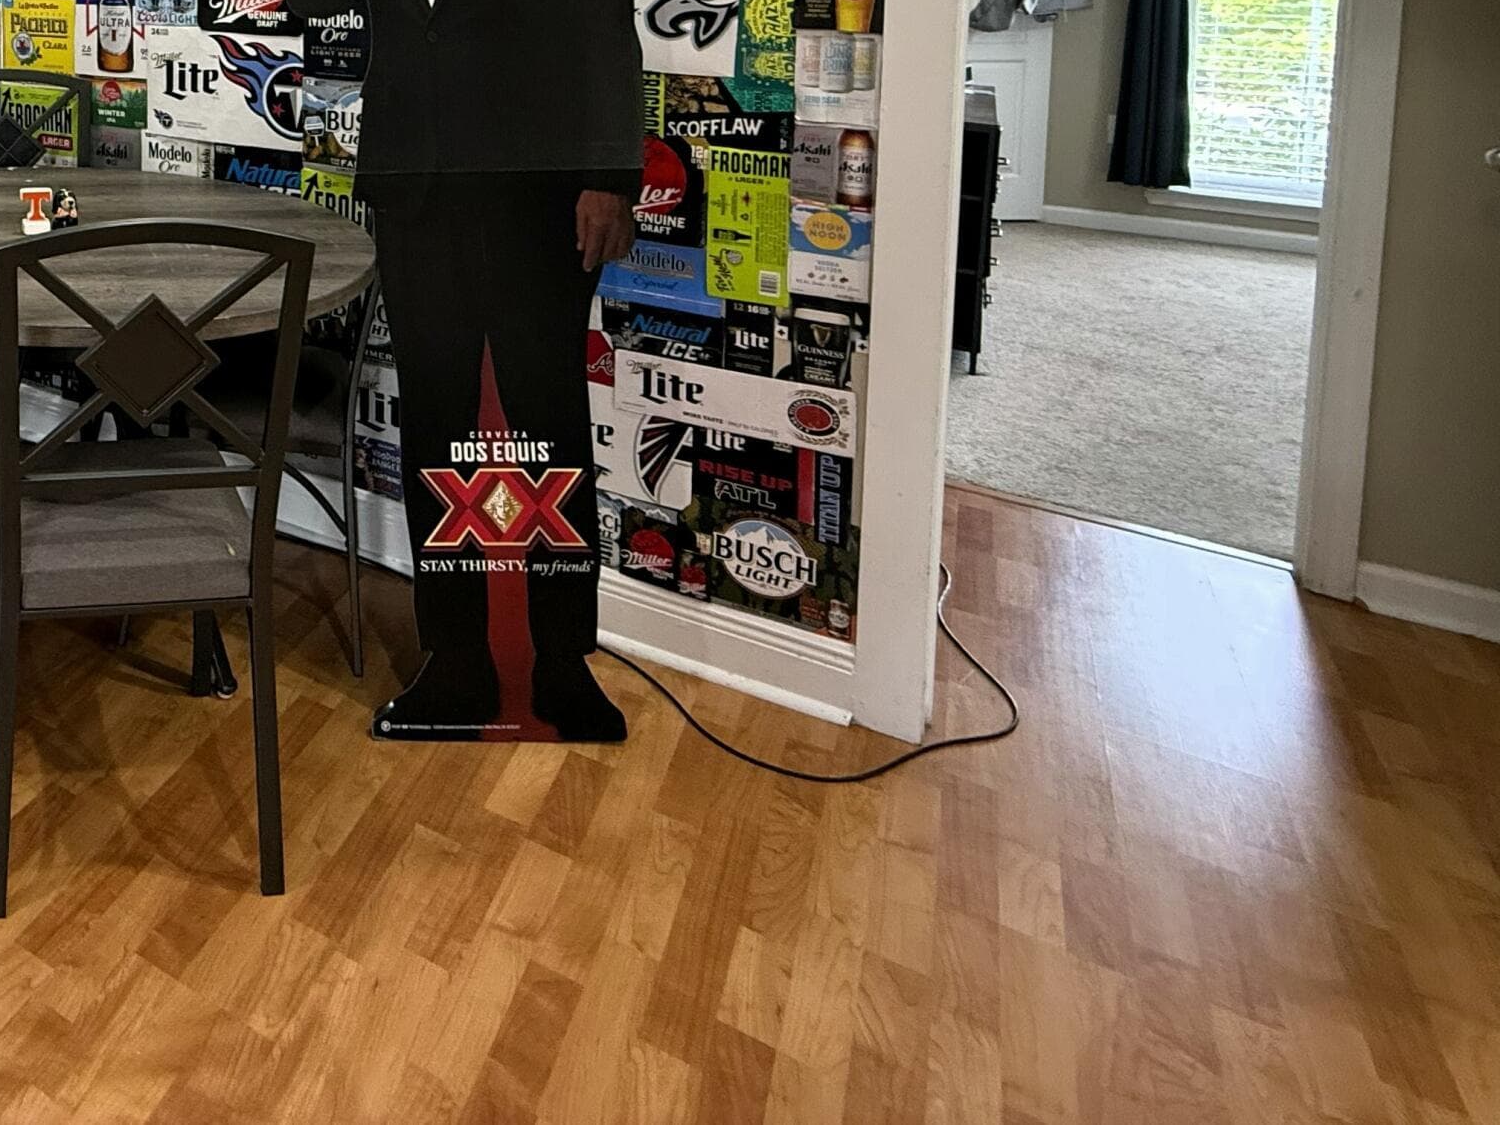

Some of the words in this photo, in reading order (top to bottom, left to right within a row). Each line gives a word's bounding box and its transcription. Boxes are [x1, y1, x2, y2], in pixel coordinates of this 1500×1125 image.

[100, 18, 130, 28] ULTRA
[247, 10, 288, 22] GENUINE
[10, 13, 68, 35] PACIFICO
[256, 20, 279, 28] DRAFT
[321, 28, 349, 43] Oro
[42, 41, 68, 51] CLARA
[163, 59, 219, 100] Lite
[97, 109, 125, 118] WINTER
[666, 118, 762, 137] SCOFFLAW
[41, 136, 71, 148] LAGER
[711, 150, 791, 179] FROGMAN
[21, 192, 51, 221] T
[640, 223, 671, 235] DRAFT
[812, 220, 844, 232] HIGH
[809, 229, 847, 241] NOON
[469, 431, 528, 439] CERVEZA
[450, 441, 488, 463] DOS
[492, 441, 550, 463] EQUIS
[699, 458, 755, 481] RISE
[760, 474, 793, 491] UP
[714, 478, 777, 510] ATL
[420, 468, 589, 546] XX
[420, 560, 456, 572] STAY
[459, 559, 528, 573] THIRSTY,
[532, 563, 548, 575] my
[550, 560, 591, 575] friends
